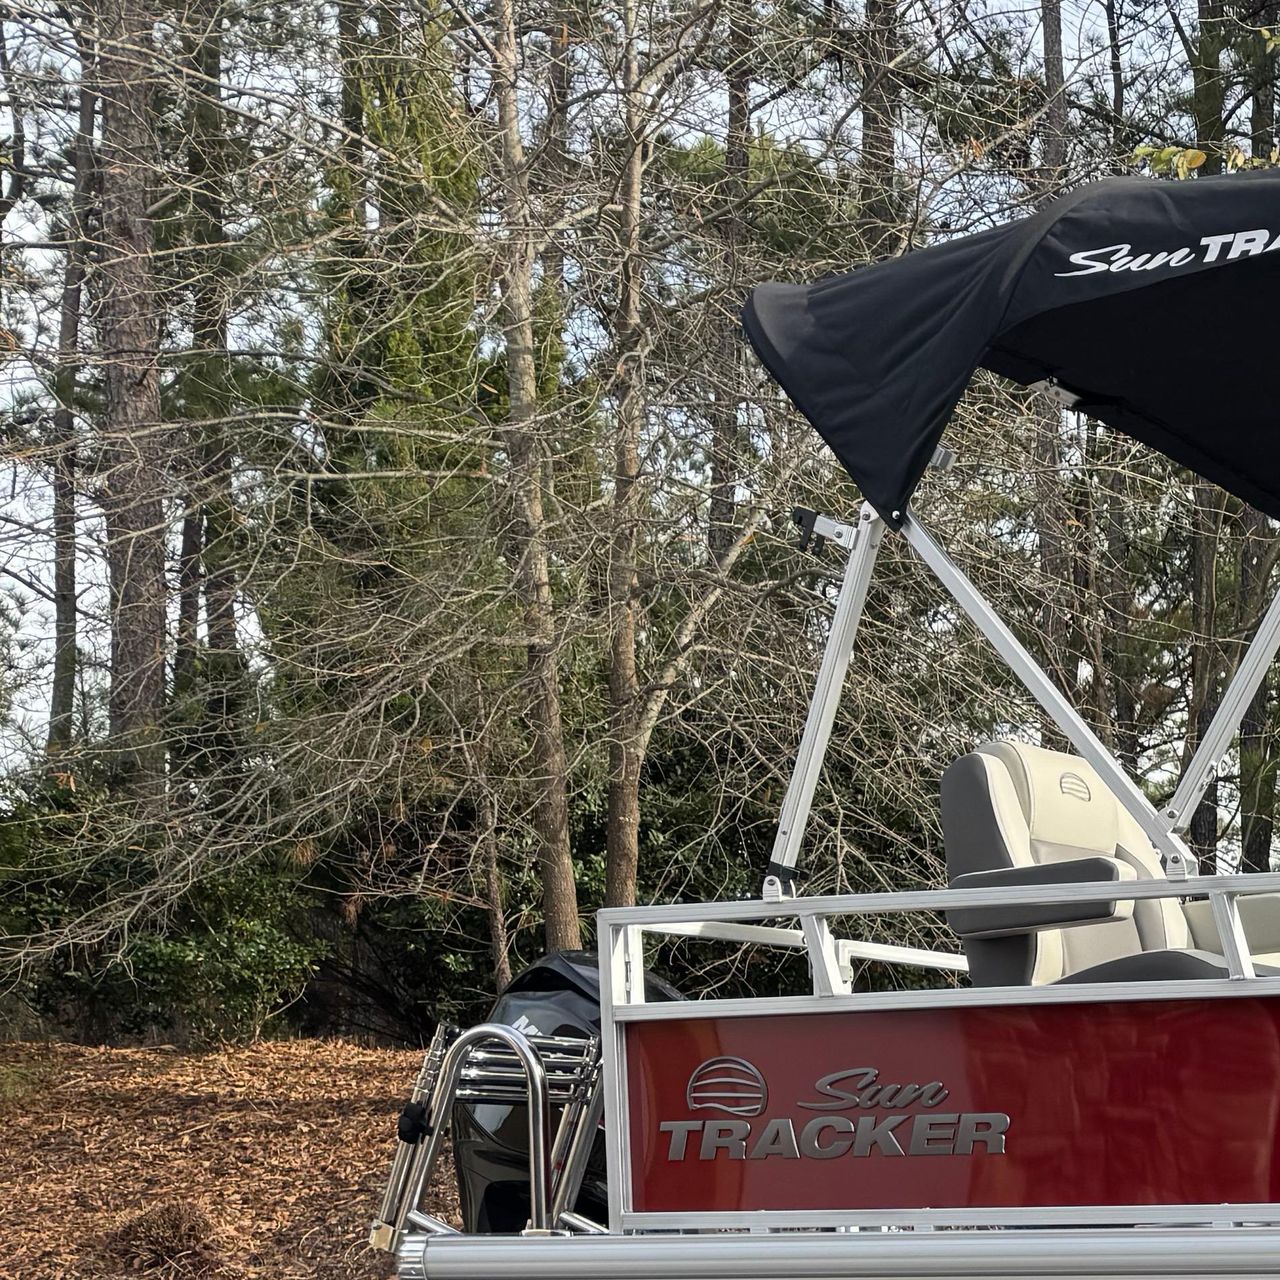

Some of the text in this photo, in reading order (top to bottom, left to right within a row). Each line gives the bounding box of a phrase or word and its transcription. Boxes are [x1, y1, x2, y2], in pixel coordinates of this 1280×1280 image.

[1054, 243, 1195, 277] Sun
[797, 1067, 949, 1111] Sun
[659, 1112, 1011, 1161] TRACKER
